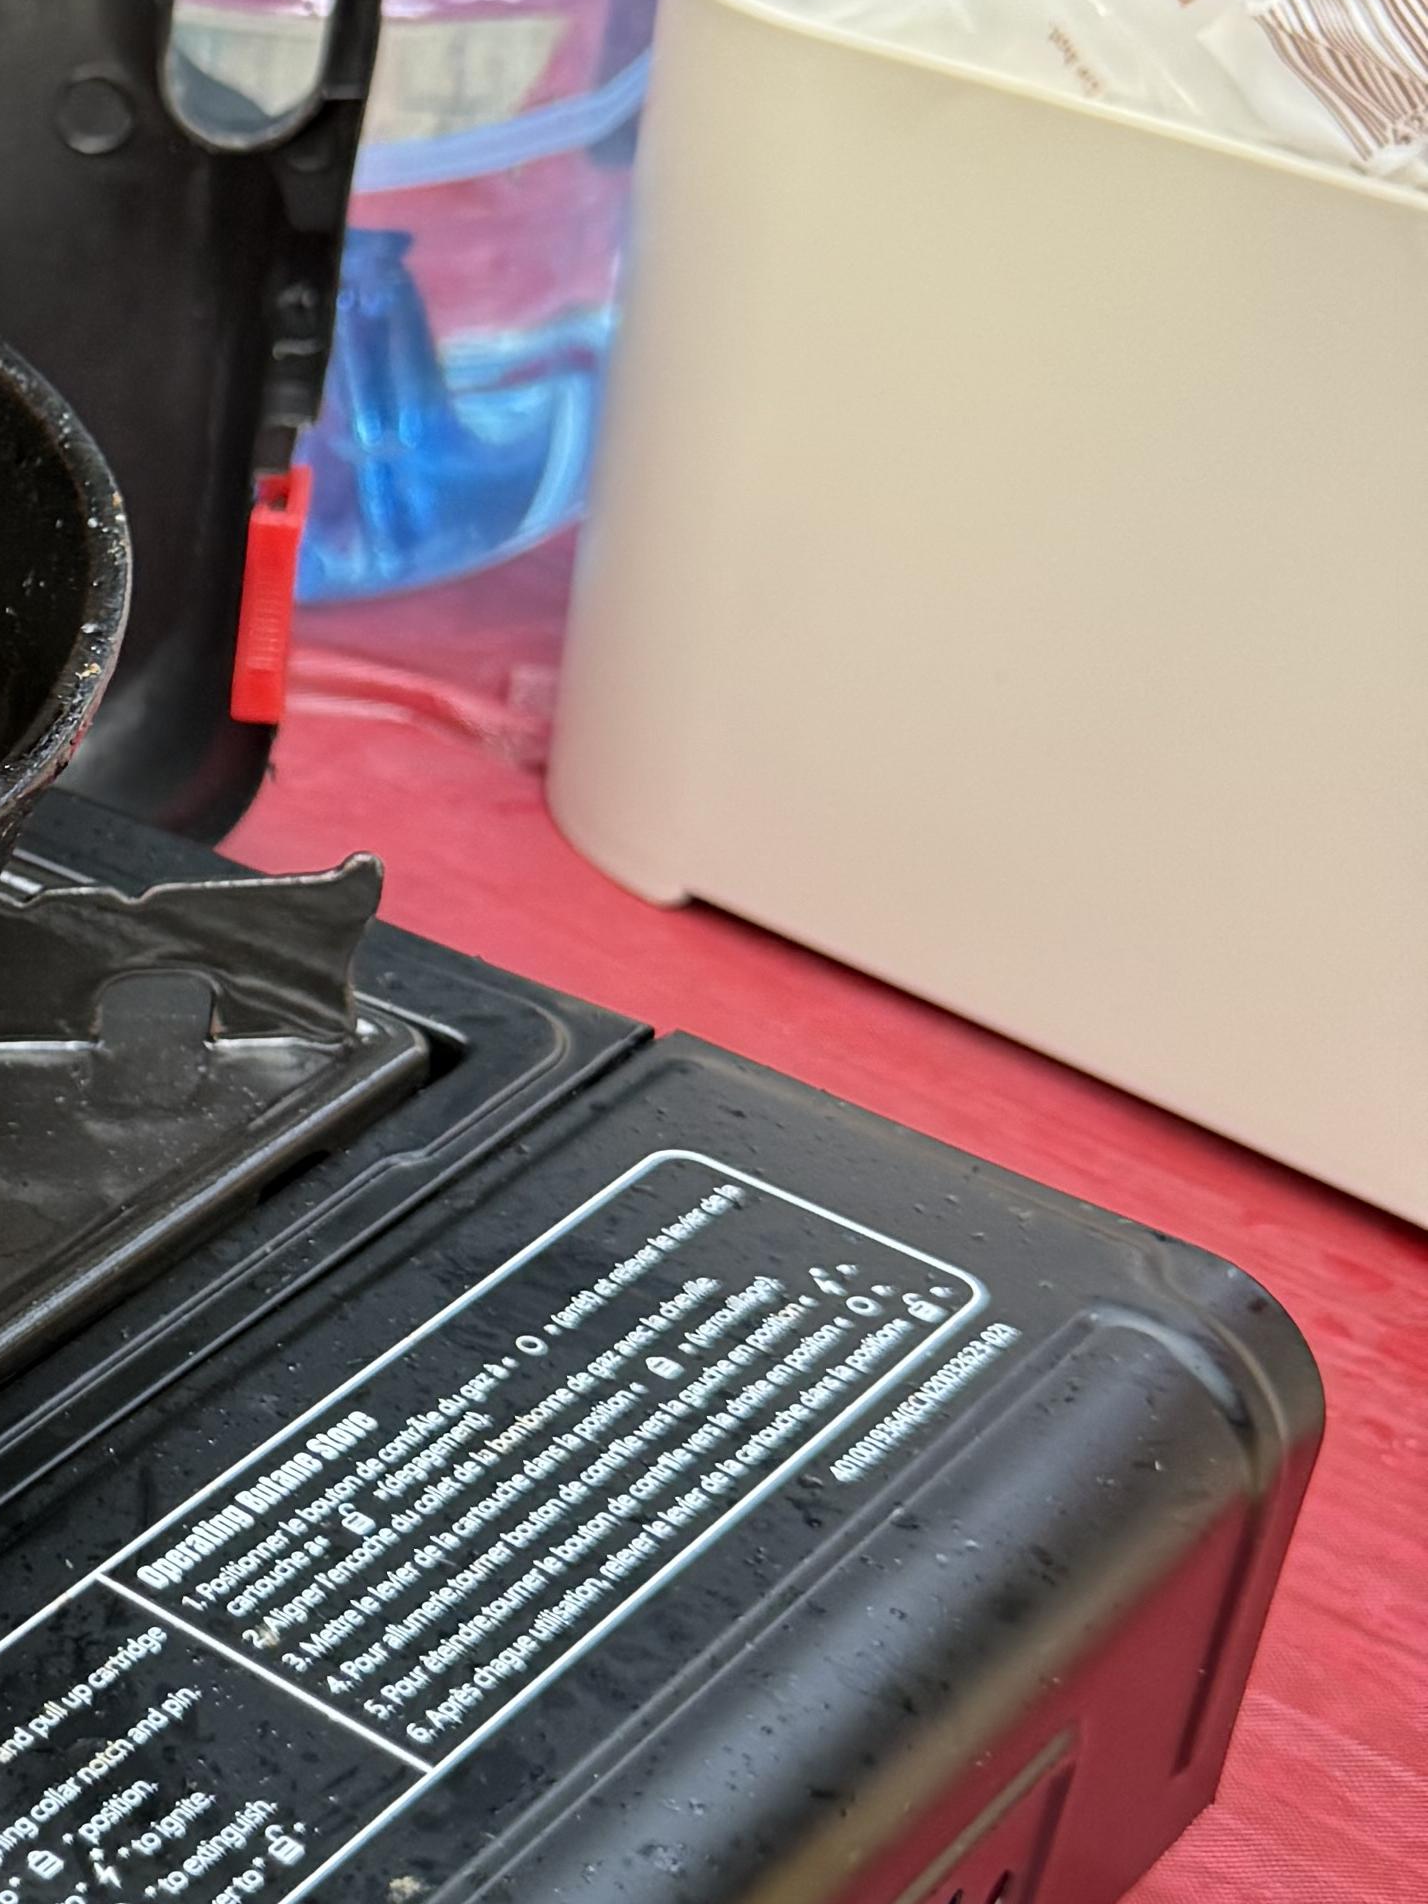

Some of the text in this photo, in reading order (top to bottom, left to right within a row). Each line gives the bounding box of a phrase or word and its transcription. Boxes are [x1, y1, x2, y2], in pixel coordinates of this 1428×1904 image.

[587, 1350, 624, 1379] gaz
[765, 1364, 795, 1385] en
[566, 1372, 595, 1393] de
[799, 1375, 844, 1409] dans
[278, 1518, 308, 1536] le
[294, 1475, 364, 1524] bouton
[355, 1457, 386, 1481] de
[438, 1394, 469, 1416] du
[459, 1372, 496, 1402] gaz
[593, 1278, 619, 1297] et
[483, 1388, 575, 1454] bombonne
[572, 1389, 638, 1441] position
[706, 1412, 738, 1430] la
[552, 1433, 584, 1451] la
[681, 1423, 725, 1453] vers
[453, 1460, 482, 1483] de
[468, 1448, 500, 1466] la
[522, 1444, 568, 1479] dans
[714, 1459, 746, 1477] la
[699, 1471, 730, 1494] de
[136, 1410, 378, 1590] Operating Butane Stove
[339, 1642, 389, 1682] Pour
[499, 1498, 568, 1548] bouton
[558, 1480, 588, 1504] de
[632, 1410, 676, 1440] vers
[657, 1399, 690, 1417] la
[727, 1344, 756, 1365] en
[451, 1473, 532, 1537] cartouche
[607, 1494, 638, 1517] de
[390, 1509, 423, 1533] du
[641, 1520, 673, 1539] le
[429, 1532, 461, 1550] la
[548, 1511, 621, 1562] bouton
[413, 1544, 448, 1568] de
[532, 1556, 565, 1575] le
[349, 1596, 381, 1615] le
[28, 1700, 68, 1739] pull
[61, 1683, 93, 1709] up
[87, 1626, 167, 1689] cartridge
[380, 1665, 431, 1706] Pour
[30, 1776, 82, 1822] collar
[76, 1738, 135, 1785] notch
[127, 1707, 169, 1745] and
[161, 1687, 202, 1720] pin.
[77, 1780, 158, 1846] position.
[182, 1800, 278, 1876] extinguish.
